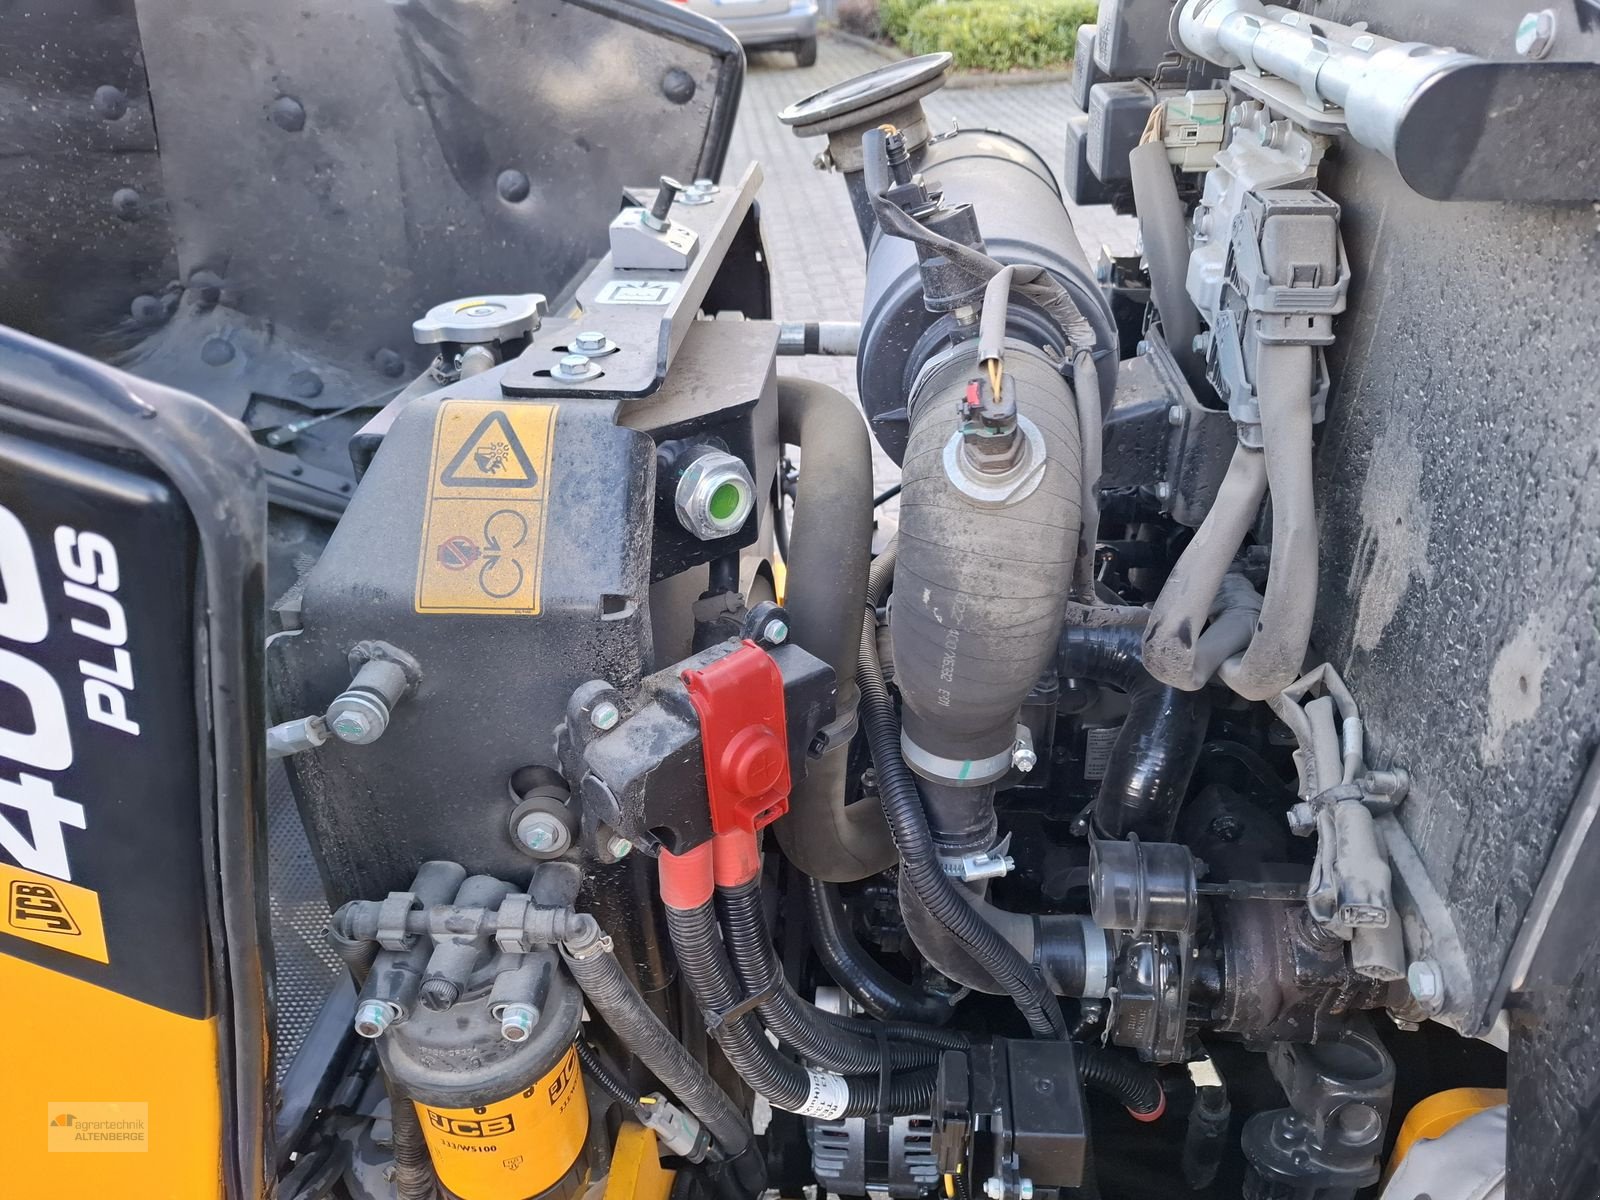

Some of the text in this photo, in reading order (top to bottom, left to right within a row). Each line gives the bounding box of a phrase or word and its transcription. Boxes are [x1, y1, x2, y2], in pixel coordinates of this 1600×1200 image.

[54, 525, 140, 736] PLUS
[16, 884, 73, 931] JCB
[429, 1110, 514, 1138] JCB
